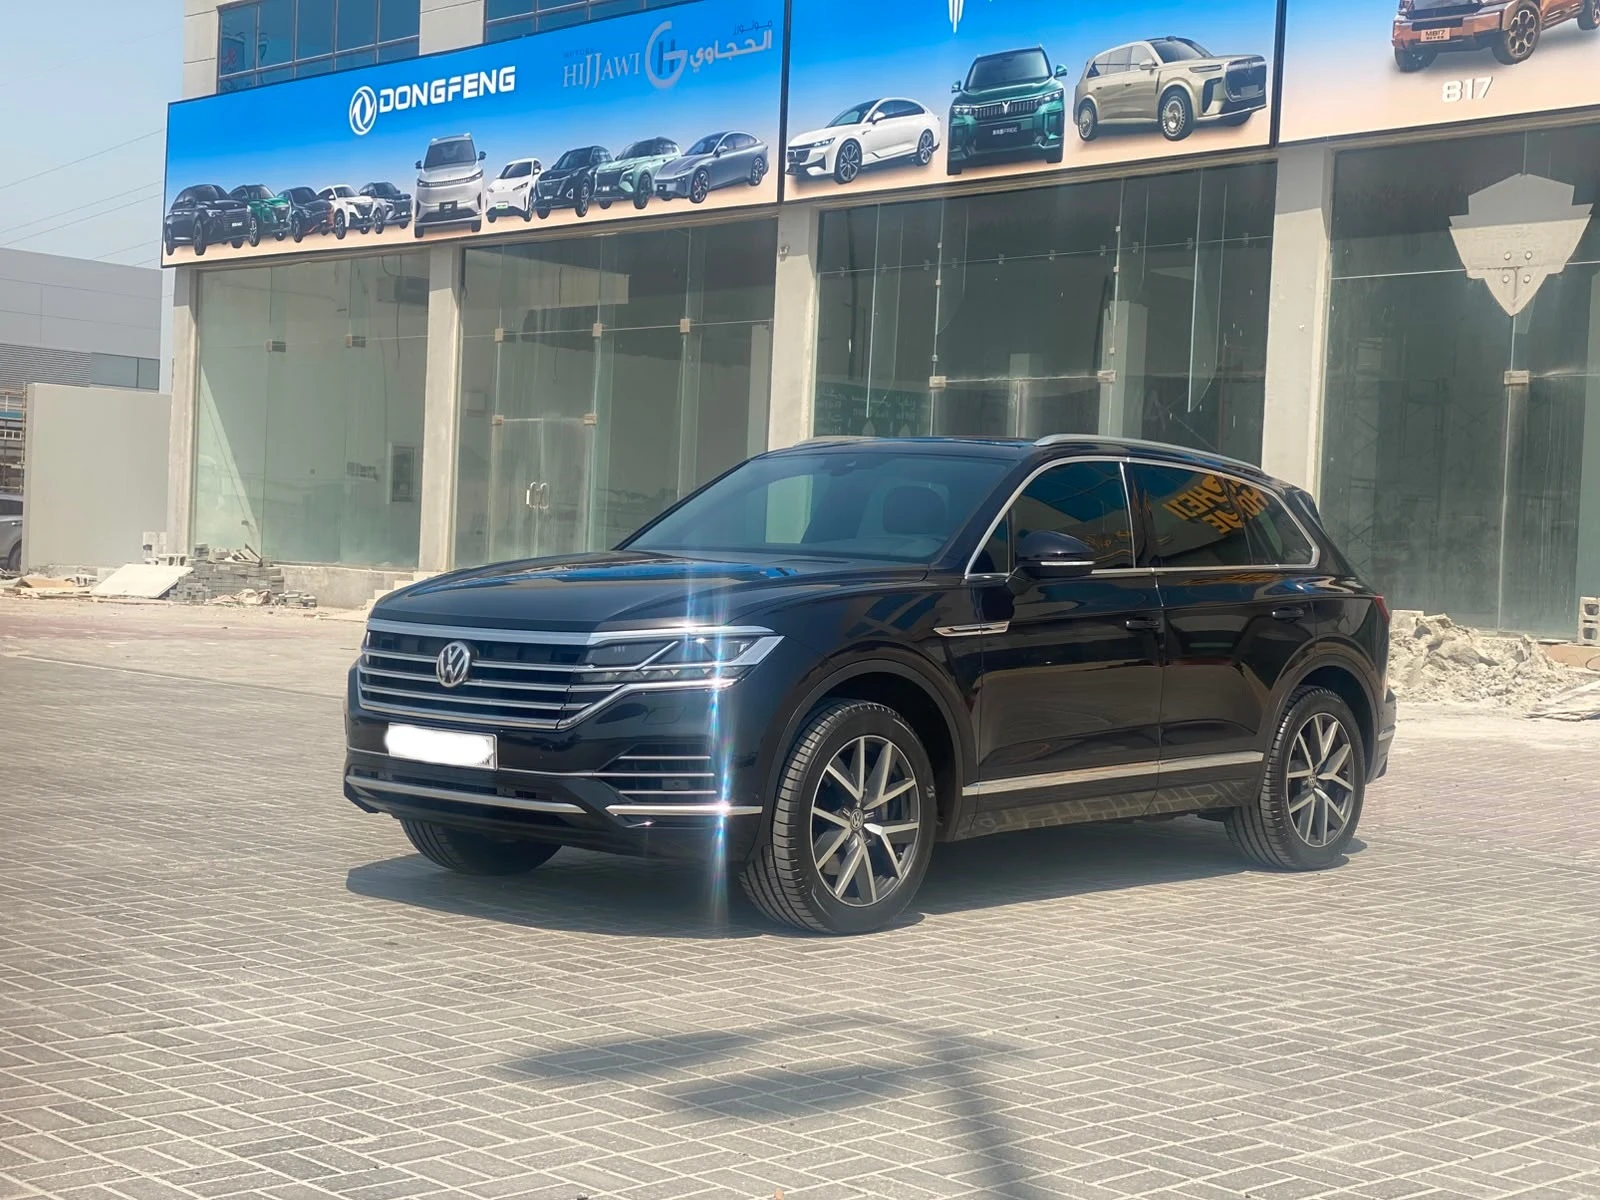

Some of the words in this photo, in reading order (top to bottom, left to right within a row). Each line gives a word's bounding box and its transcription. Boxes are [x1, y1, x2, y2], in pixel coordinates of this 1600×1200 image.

[563, 52, 640, 89] HIJJAWI
[690, 29, 772, 73] الحجاوي
[379, 65, 516, 114] DONGFENG
[1442, 76, 1494, 103] 817
